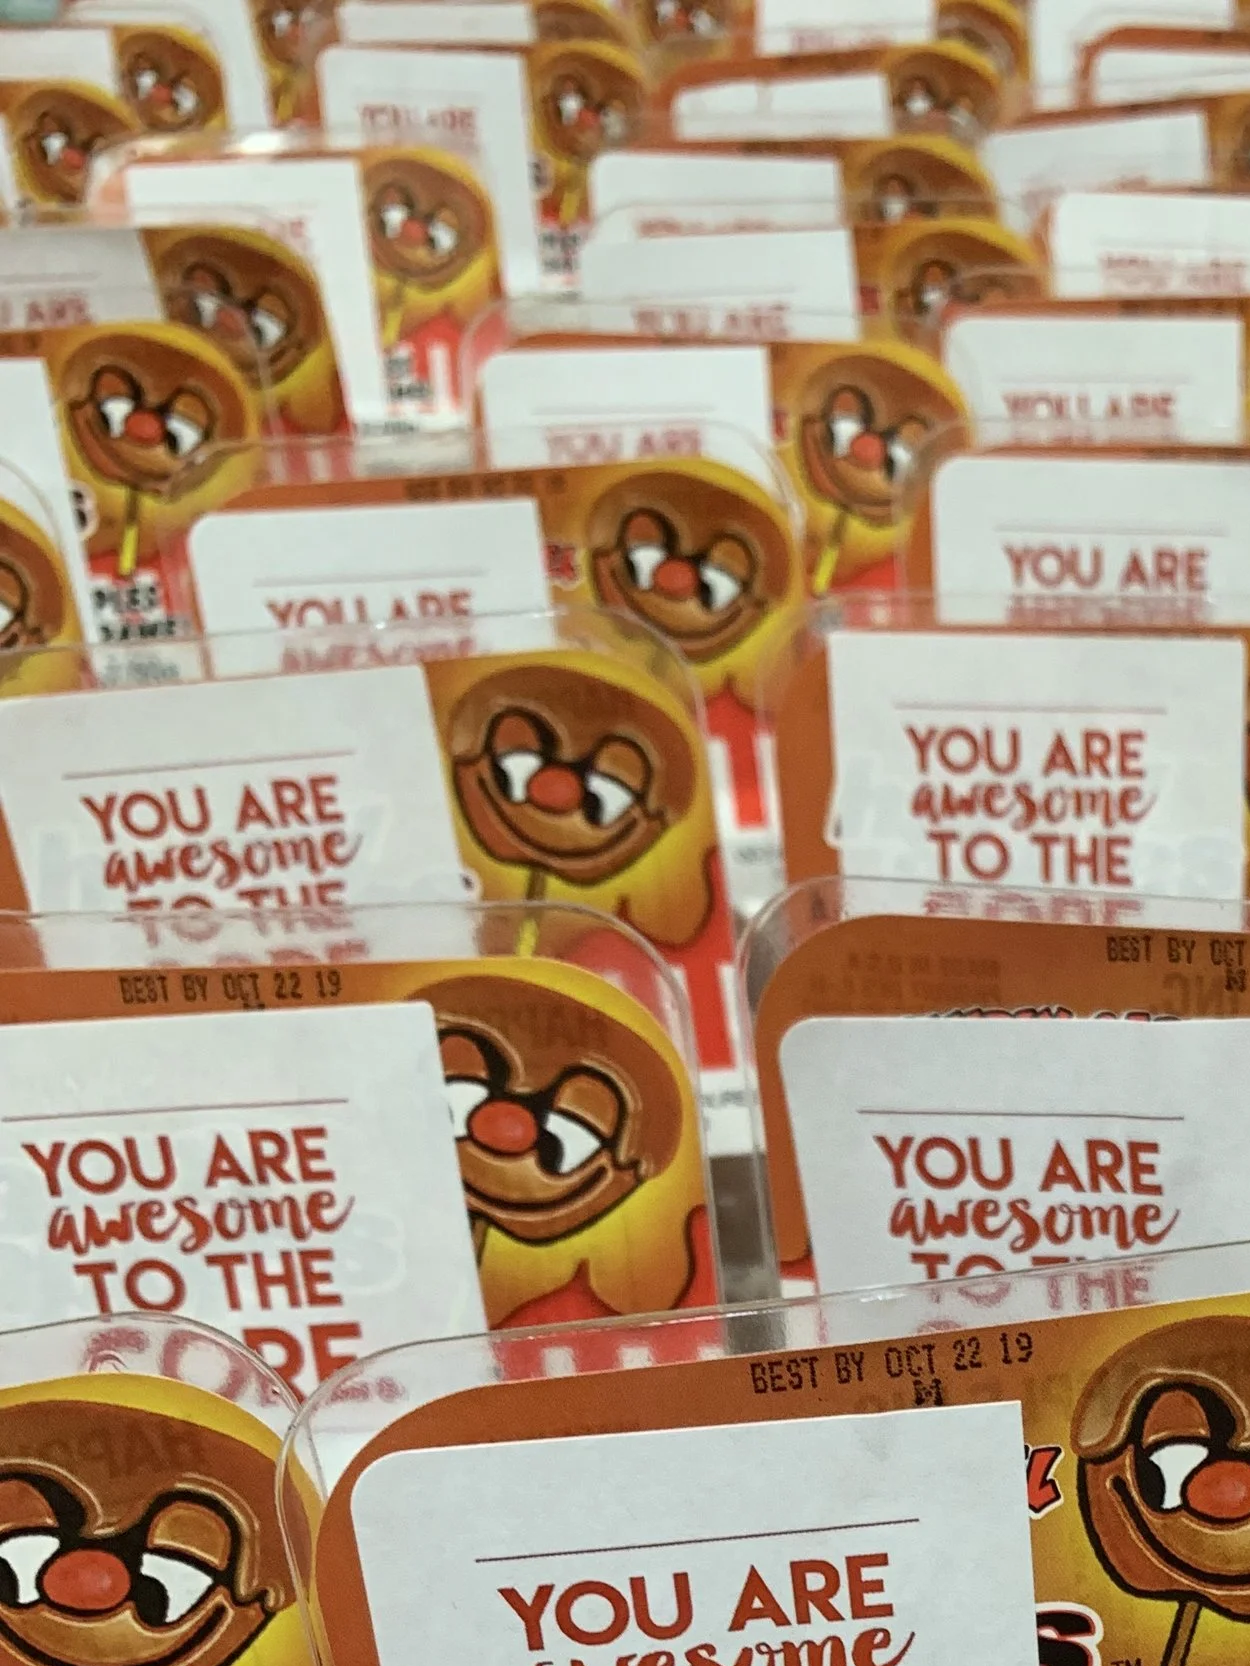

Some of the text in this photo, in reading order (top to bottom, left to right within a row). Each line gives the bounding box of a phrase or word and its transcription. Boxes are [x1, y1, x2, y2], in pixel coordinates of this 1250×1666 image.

[1003, 545, 1211, 592] YOU ARE
[906, 726, 1148, 779] YOU ARE
[80, 775, 348, 846] YOU ARE
[910, 779, 1160, 831] awesome
[102, 830, 365, 893] awesome
[926, 830, 1135, 886] TO THE
[1106, 935, 1154, 964] BEST
[1168, 938, 1197, 965] BY
[1209, 939, 1247, 967] OCT
[120, 970, 342, 1005] BEST BY OCT 22 19
[22, 1126, 337, 1198] YOU ARE
[874, 1135, 1164, 1196] YOU ARE
[47, 1194, 356, 1255] awesome
[888, 1197, 1180, 1253] awesome
[74, 1250, 344, 1318] TO THE
[750, 1331, 1034, 1394] BEST BY OCT 22 19
[497, 1552, 895, 1652] YOU ARE
